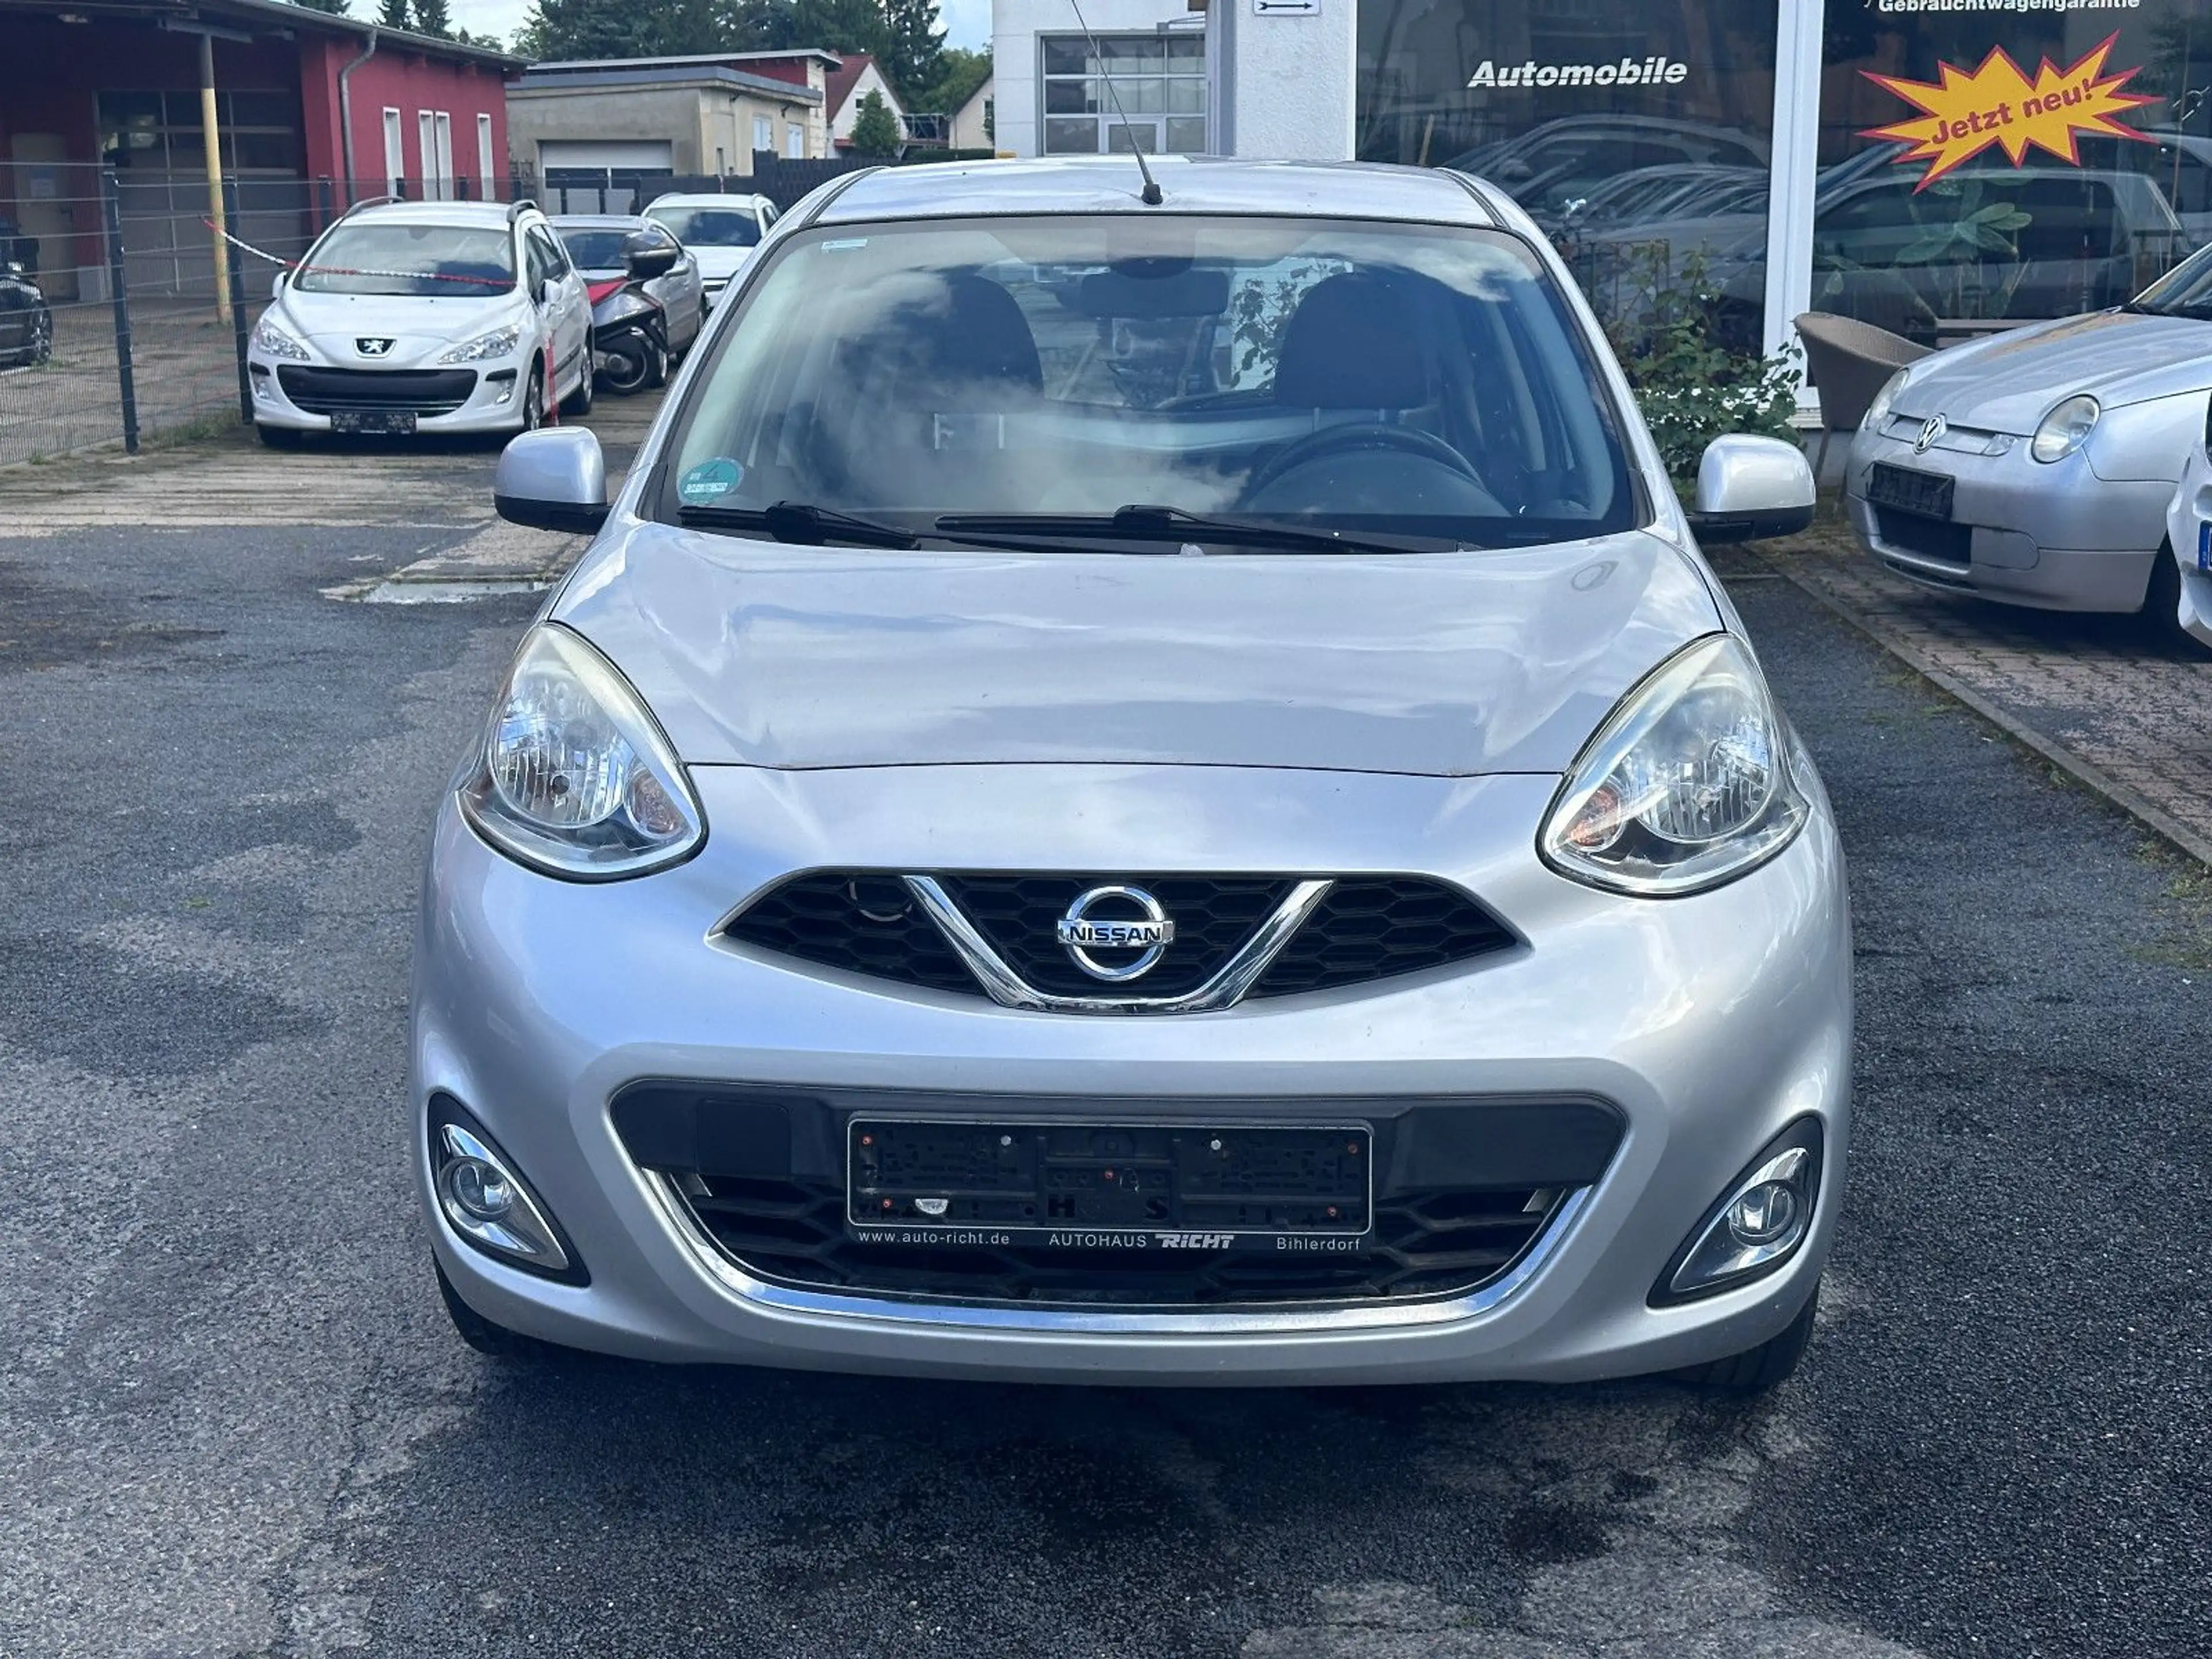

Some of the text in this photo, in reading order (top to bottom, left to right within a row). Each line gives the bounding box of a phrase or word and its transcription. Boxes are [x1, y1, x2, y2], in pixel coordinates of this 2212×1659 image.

[1467, 56, 1688, 88] Automobile
[1931, 78, 2092, 144] Jetzt neu!
[1070, 926, 1161, 941] NISSAN
[858, 1232, 1010, 1244] www.auto-richt.de
[1048, 1233, 1147, 1247] AUTOHAUS
[1277, 1237, 1361, 1250] Bihlerdorf
